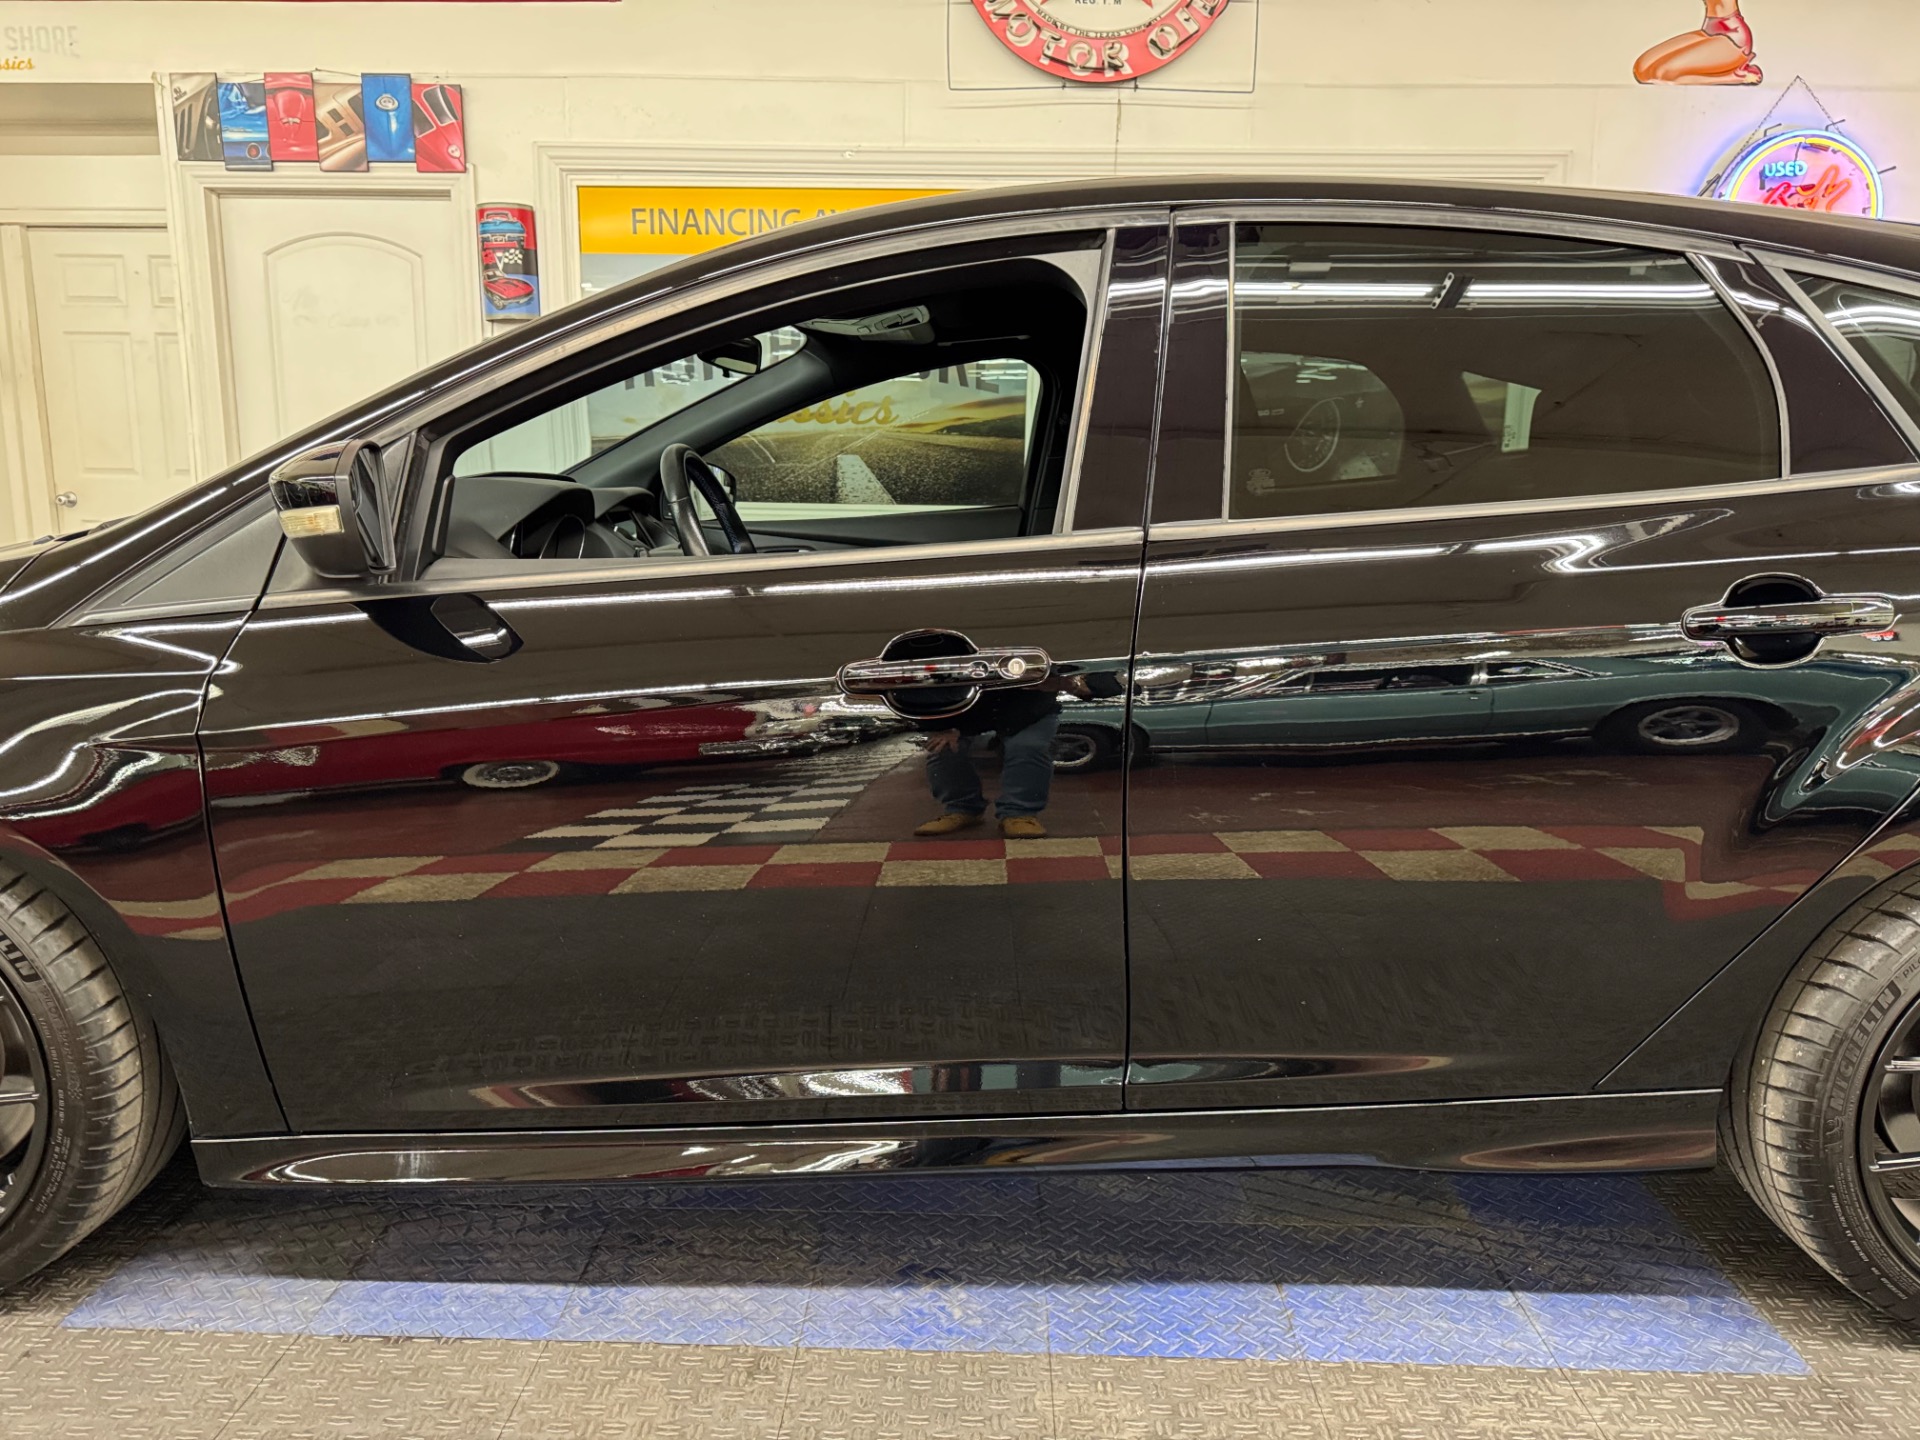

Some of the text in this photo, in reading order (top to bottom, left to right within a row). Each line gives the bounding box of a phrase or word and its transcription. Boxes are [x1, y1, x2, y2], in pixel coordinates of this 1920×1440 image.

[1075, 28, 1090, 37] THE
[1093, 30, 1121, 39] TEXAS
[1125, 14, 1162, 34] COMPNY
[4, 25, 80, 58] SHORE
[0, 56, 35, 71] sics
[1764, 160, 1808, 177] USED
[631, 208, 801, 236] FINANCING
[1829, 987, 1896, 1111] MICHELIN
